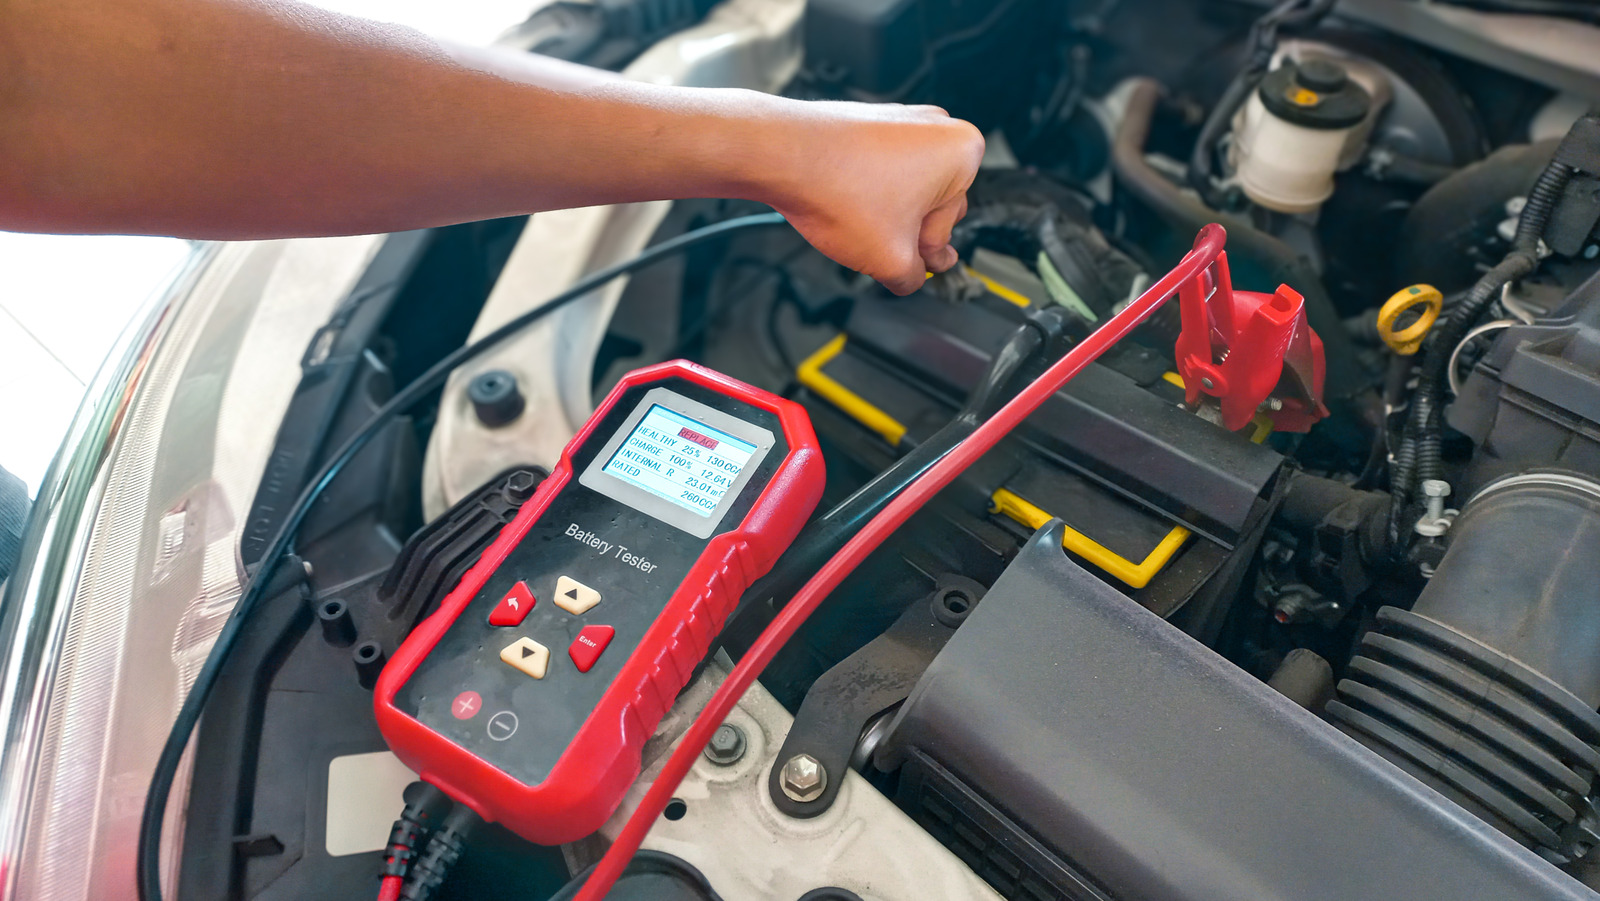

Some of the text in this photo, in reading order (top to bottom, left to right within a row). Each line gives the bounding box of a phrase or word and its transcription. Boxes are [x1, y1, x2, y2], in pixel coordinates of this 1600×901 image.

[629, 437, 664, 457] CHARGE
[669, 454, 693, 470] 100%
[638, 426, 678, 447] HEALTHY
[681, 445, 702, 458] 25%
[611, 459, 641, 477] RATED
[621, 448, 662, 472] INTERNAL
[666, 468, 675, 477] R
[564, 522, 658, 575] Battery Tester
[578, 635, 597, 648] Enter
